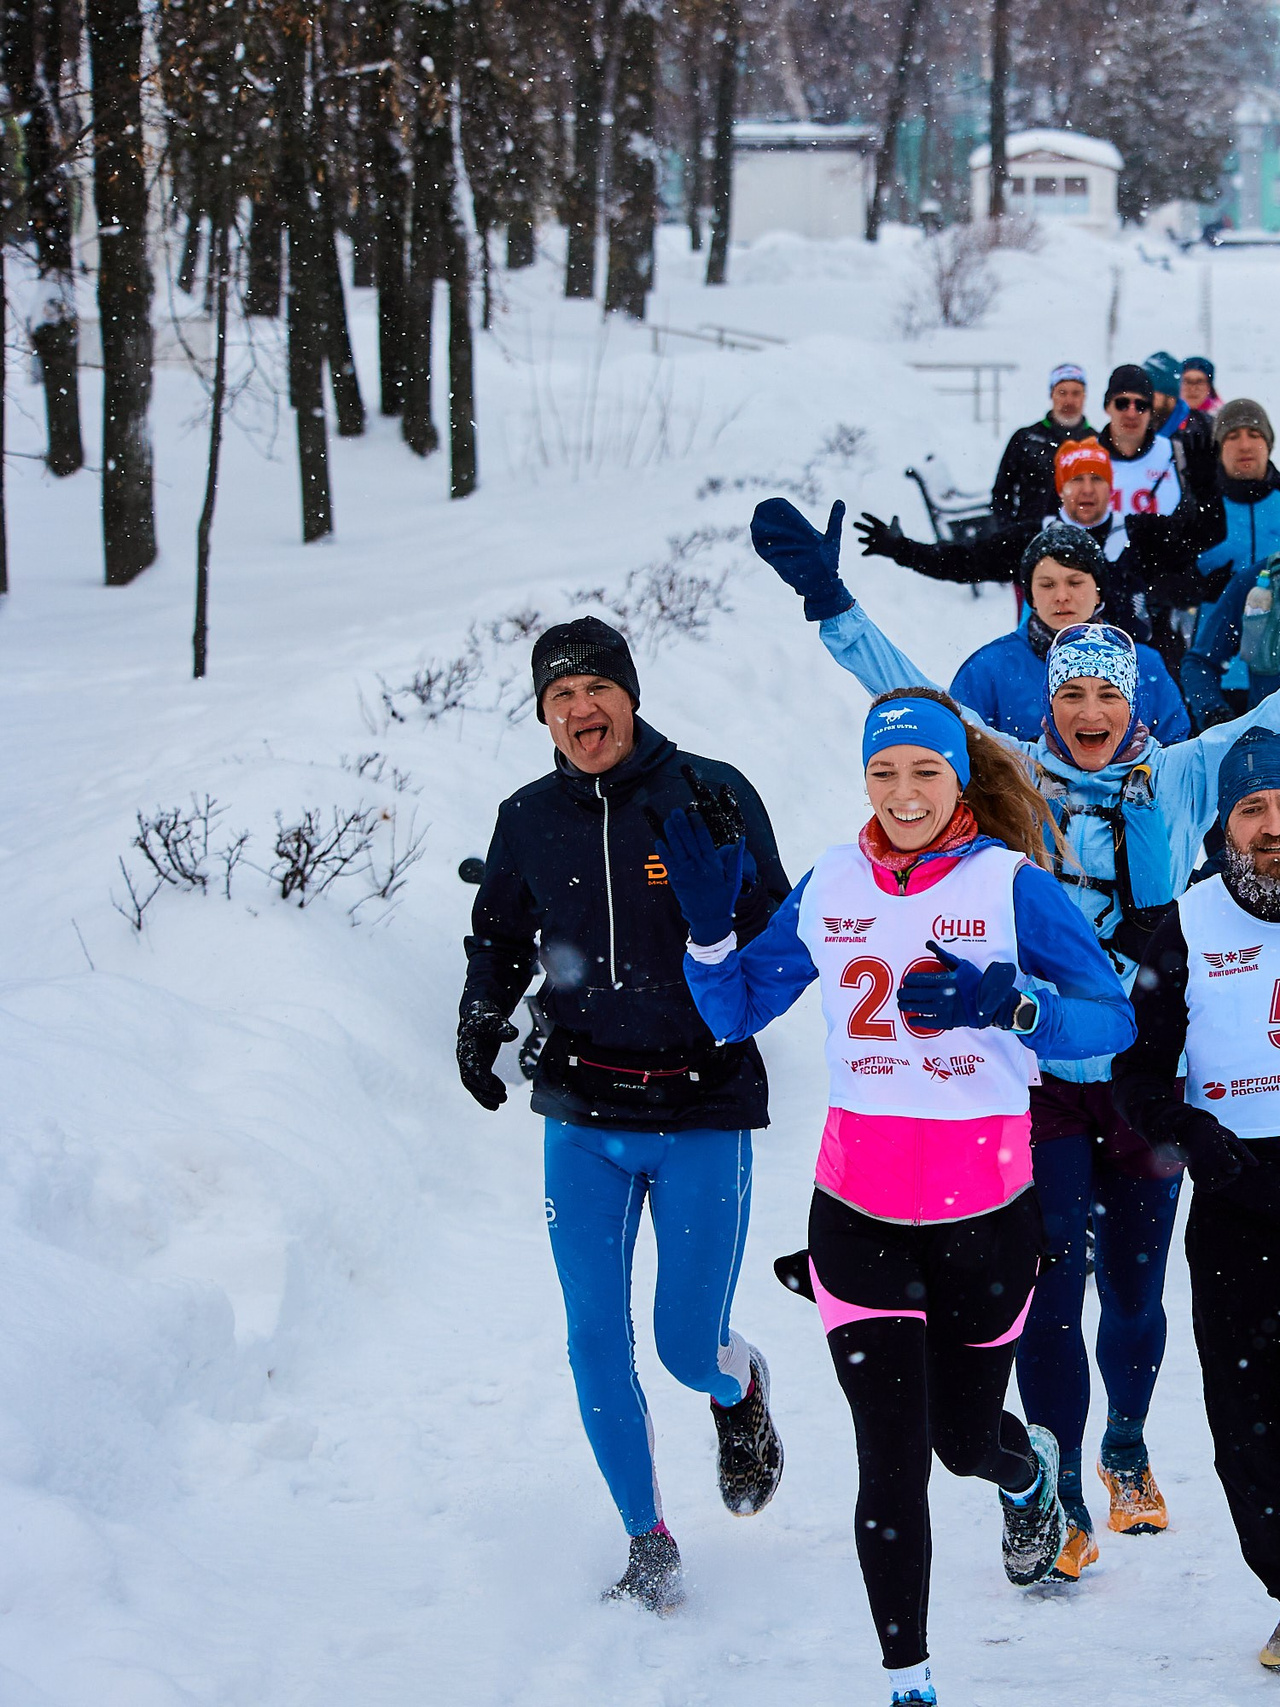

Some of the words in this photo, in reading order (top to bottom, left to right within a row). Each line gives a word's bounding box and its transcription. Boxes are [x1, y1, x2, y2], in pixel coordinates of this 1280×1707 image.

[1094, 662, 1111, 670] ULTRA
[872, 727, 884, 736] MAD
[940, 919, 986, 937] НЦВ
[1208, 963, 1260, 978] ВИНТОКРЫЛЫЕ
[851, 1055, 911, 1070] ВЕРТОЛЕТЫ
[953, 1064, 976, 1076] НЦВ
[1231, 1084, 1280, 1098] РОССИИ
